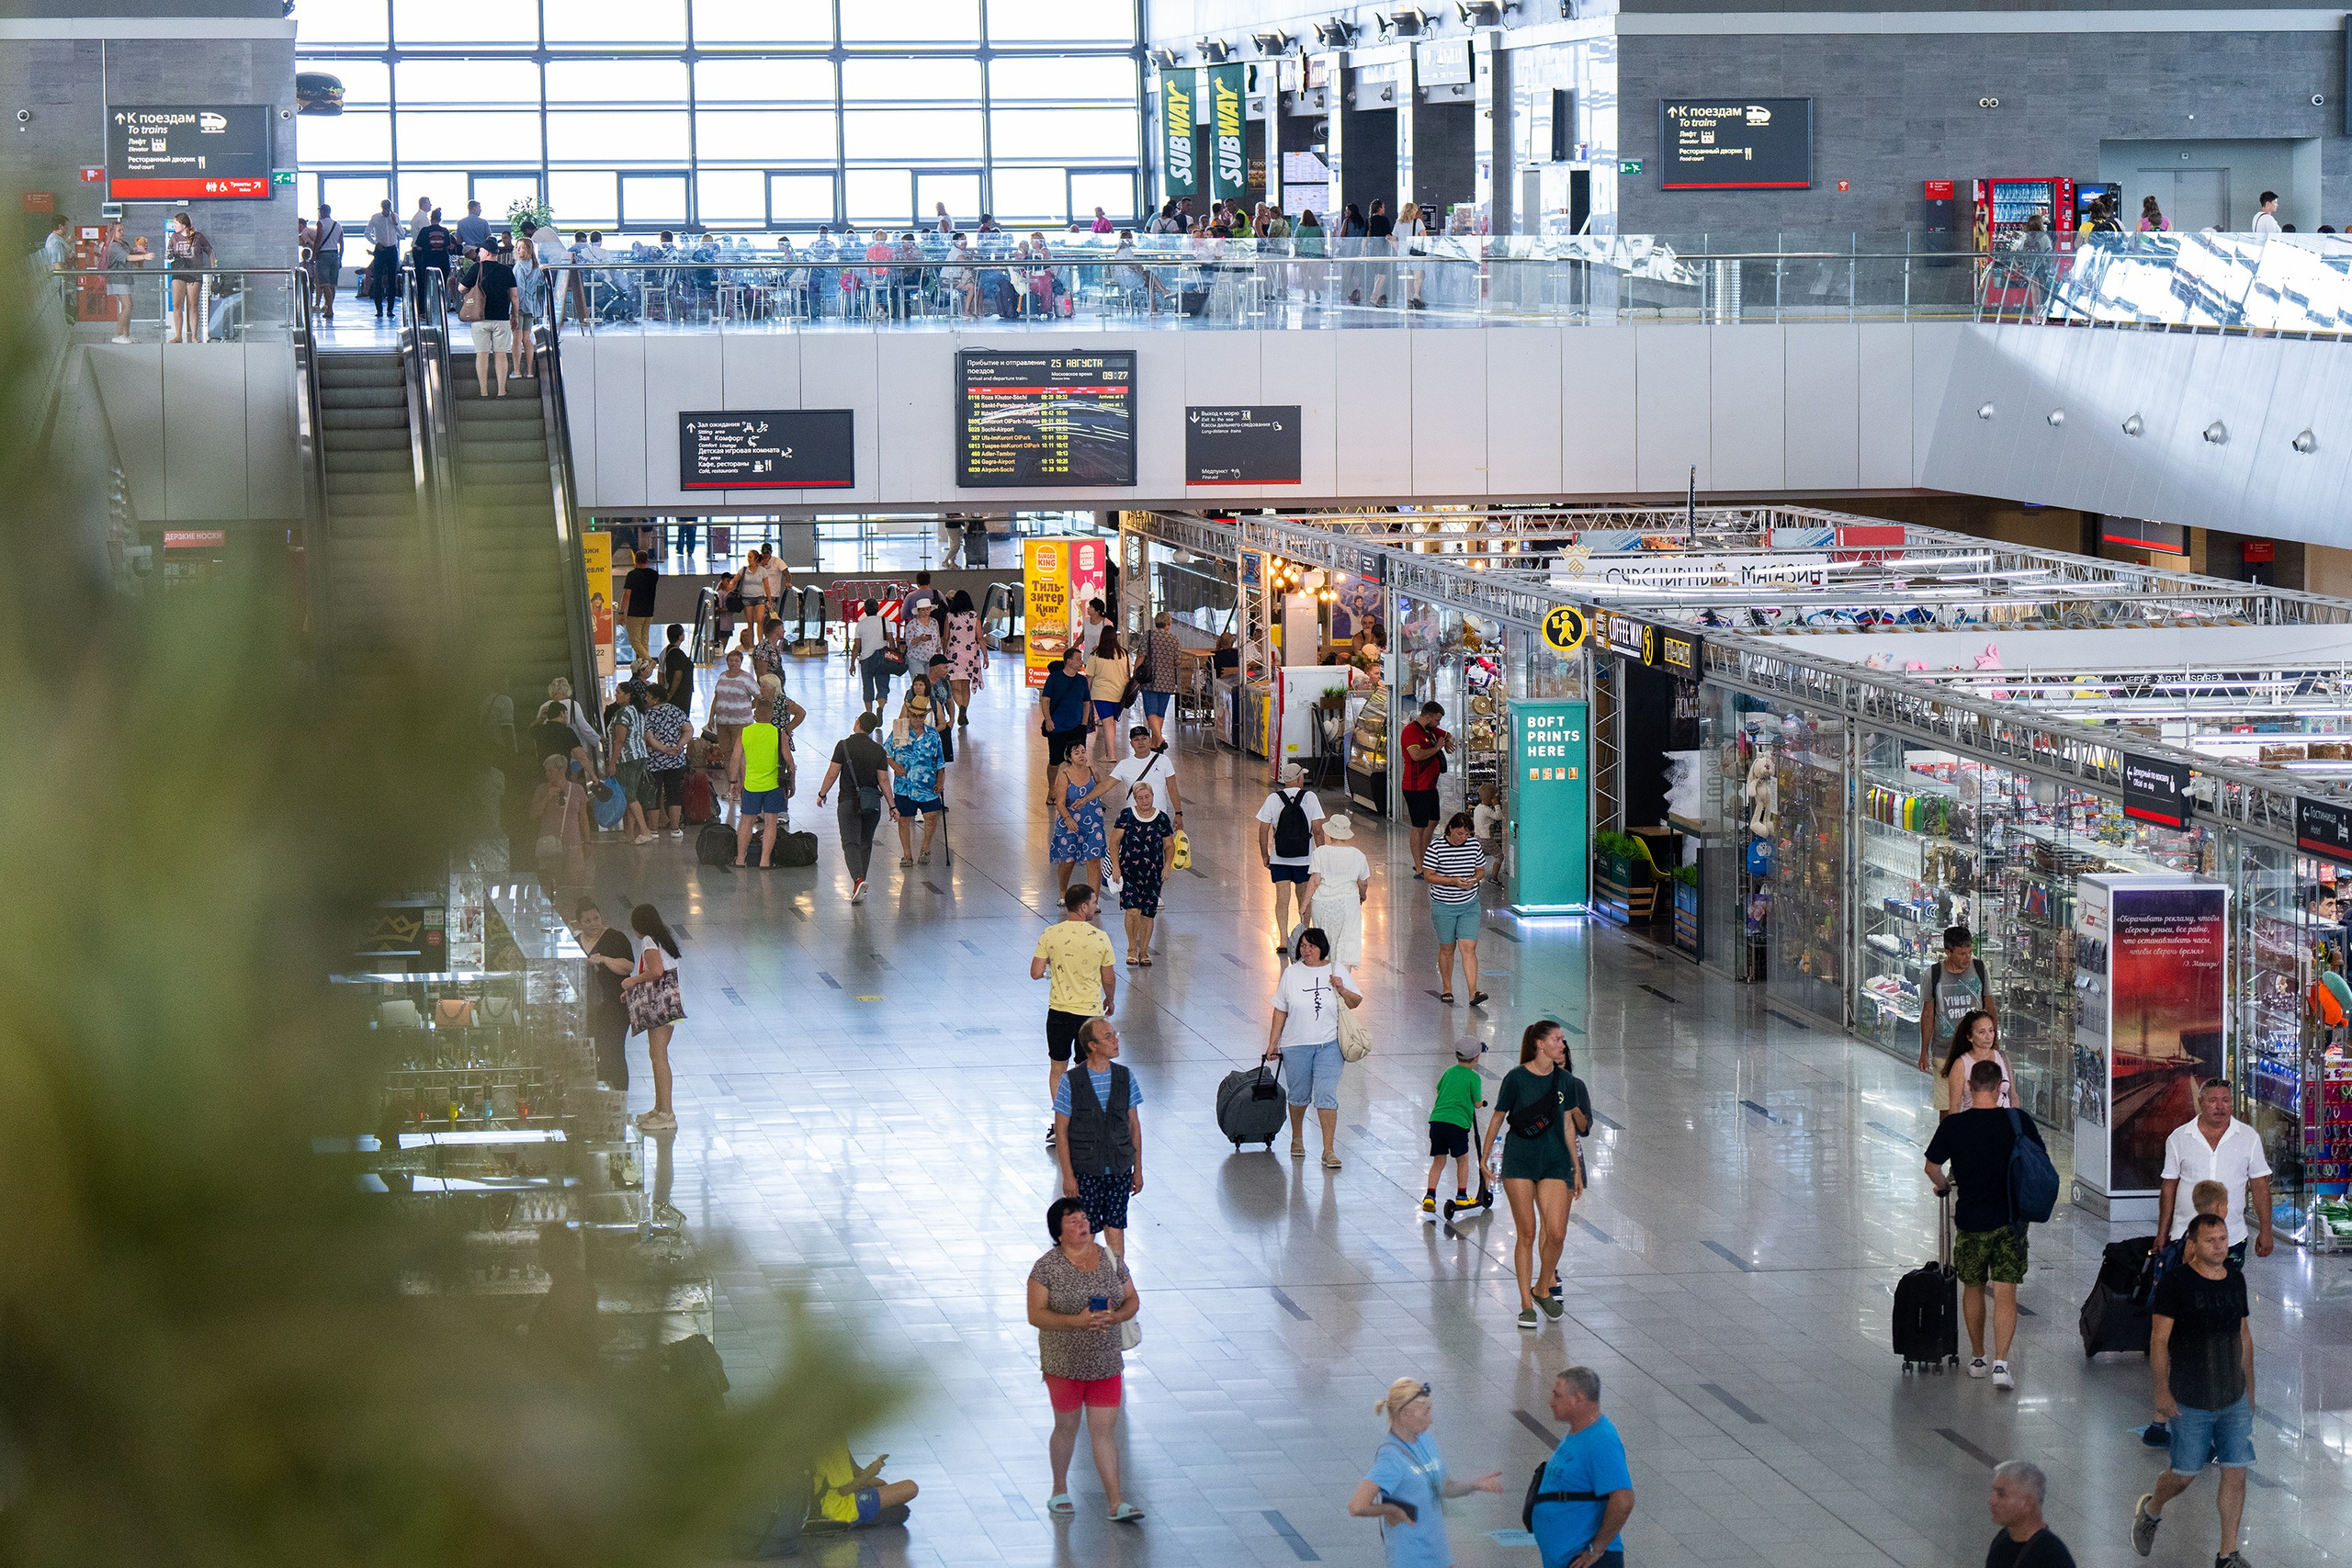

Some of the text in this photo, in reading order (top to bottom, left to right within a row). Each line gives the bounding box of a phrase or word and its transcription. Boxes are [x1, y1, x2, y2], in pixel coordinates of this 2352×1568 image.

[1679, 106, 1742, 118] К поездам
[128, 112, 196, 125] К поездам
[1679, 118, 1717, 128] To trains
[128, 125, 168, 134] To trains
[1166, 79, 1193, 187] SUBWAY
[1214, 76, 1244, 188] SUBWAY
[1679, 130, 1697, 139] Лифт
[128, 138, 147, 147] Лифт
[967, 359, 1000, 367] Прибытие
[1050, 358, 1102, 367] 25 АВГУСТА
[1102, 371, 1129, 380] 09:27
[715, 434, 744, 443] Комфорт
[165, 532, 222, 541] ДЕРЗКИЕ НОСКИ
[1032, 581, 1064, 592] Тиль-
[1031, 593, 1064, 605] зитер
[1035, 604, 1058, 616] Кинг
[1610, 616, 1630, 645] COFFEE
[1630, 622, 1643, 649] WAY
[1528, 716, 1565, 728] BOFT
[1528, 730, 1579, 742] PRINTS
[1528, 745, 1566, 757] HERE
[2311, 806, 2336, 825] Гостиница
[2164, 915, 2196, 925] рекламу,
[2197, 914, 2220, 922] чтобы
[2125, 926, 2149, 934] сберечь
[2151, 926, 2175, 936] деньги,
[1944, 994, 1972, 1006] VIBES
